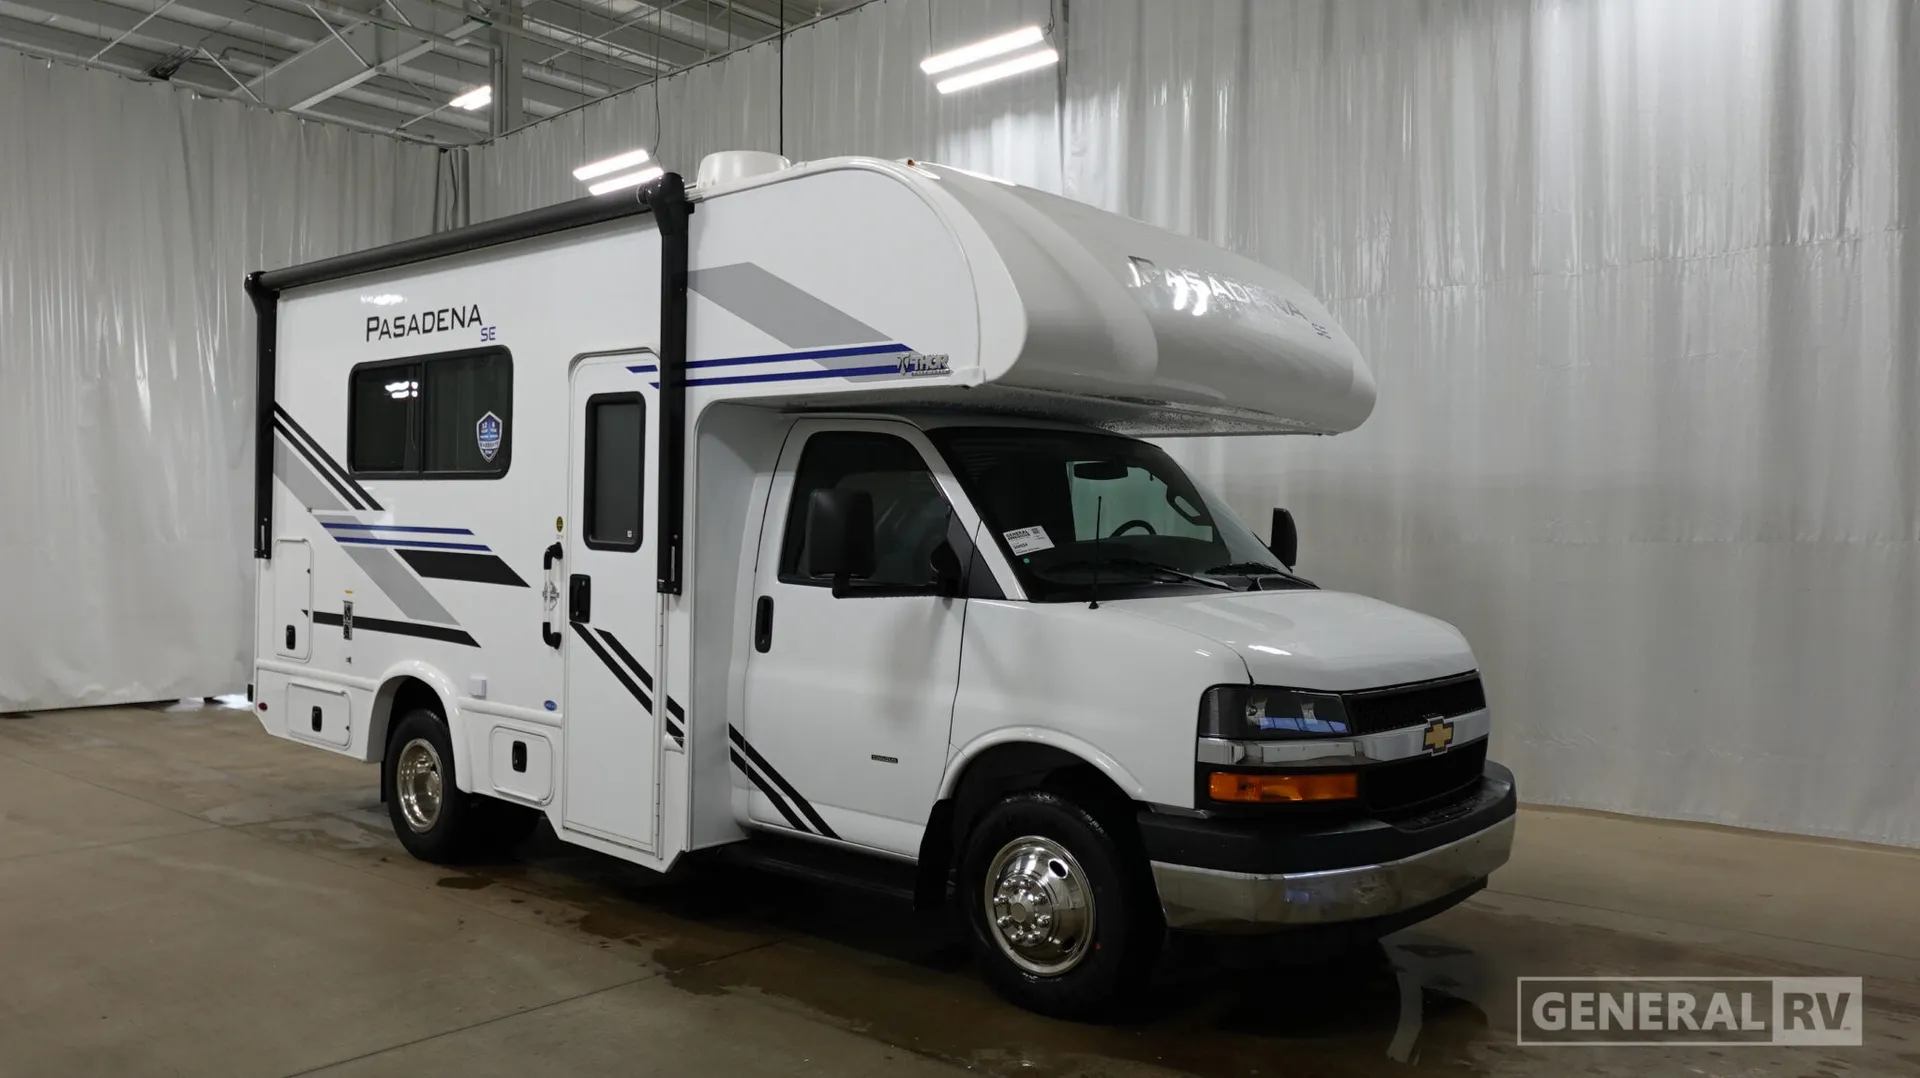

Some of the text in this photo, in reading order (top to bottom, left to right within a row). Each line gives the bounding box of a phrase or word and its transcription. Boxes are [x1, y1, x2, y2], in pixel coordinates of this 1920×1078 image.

[366, 304, 483, 342] PASADENA
[480, 326, 497, 342] SE
[911, 353, 950, 372] THOR
